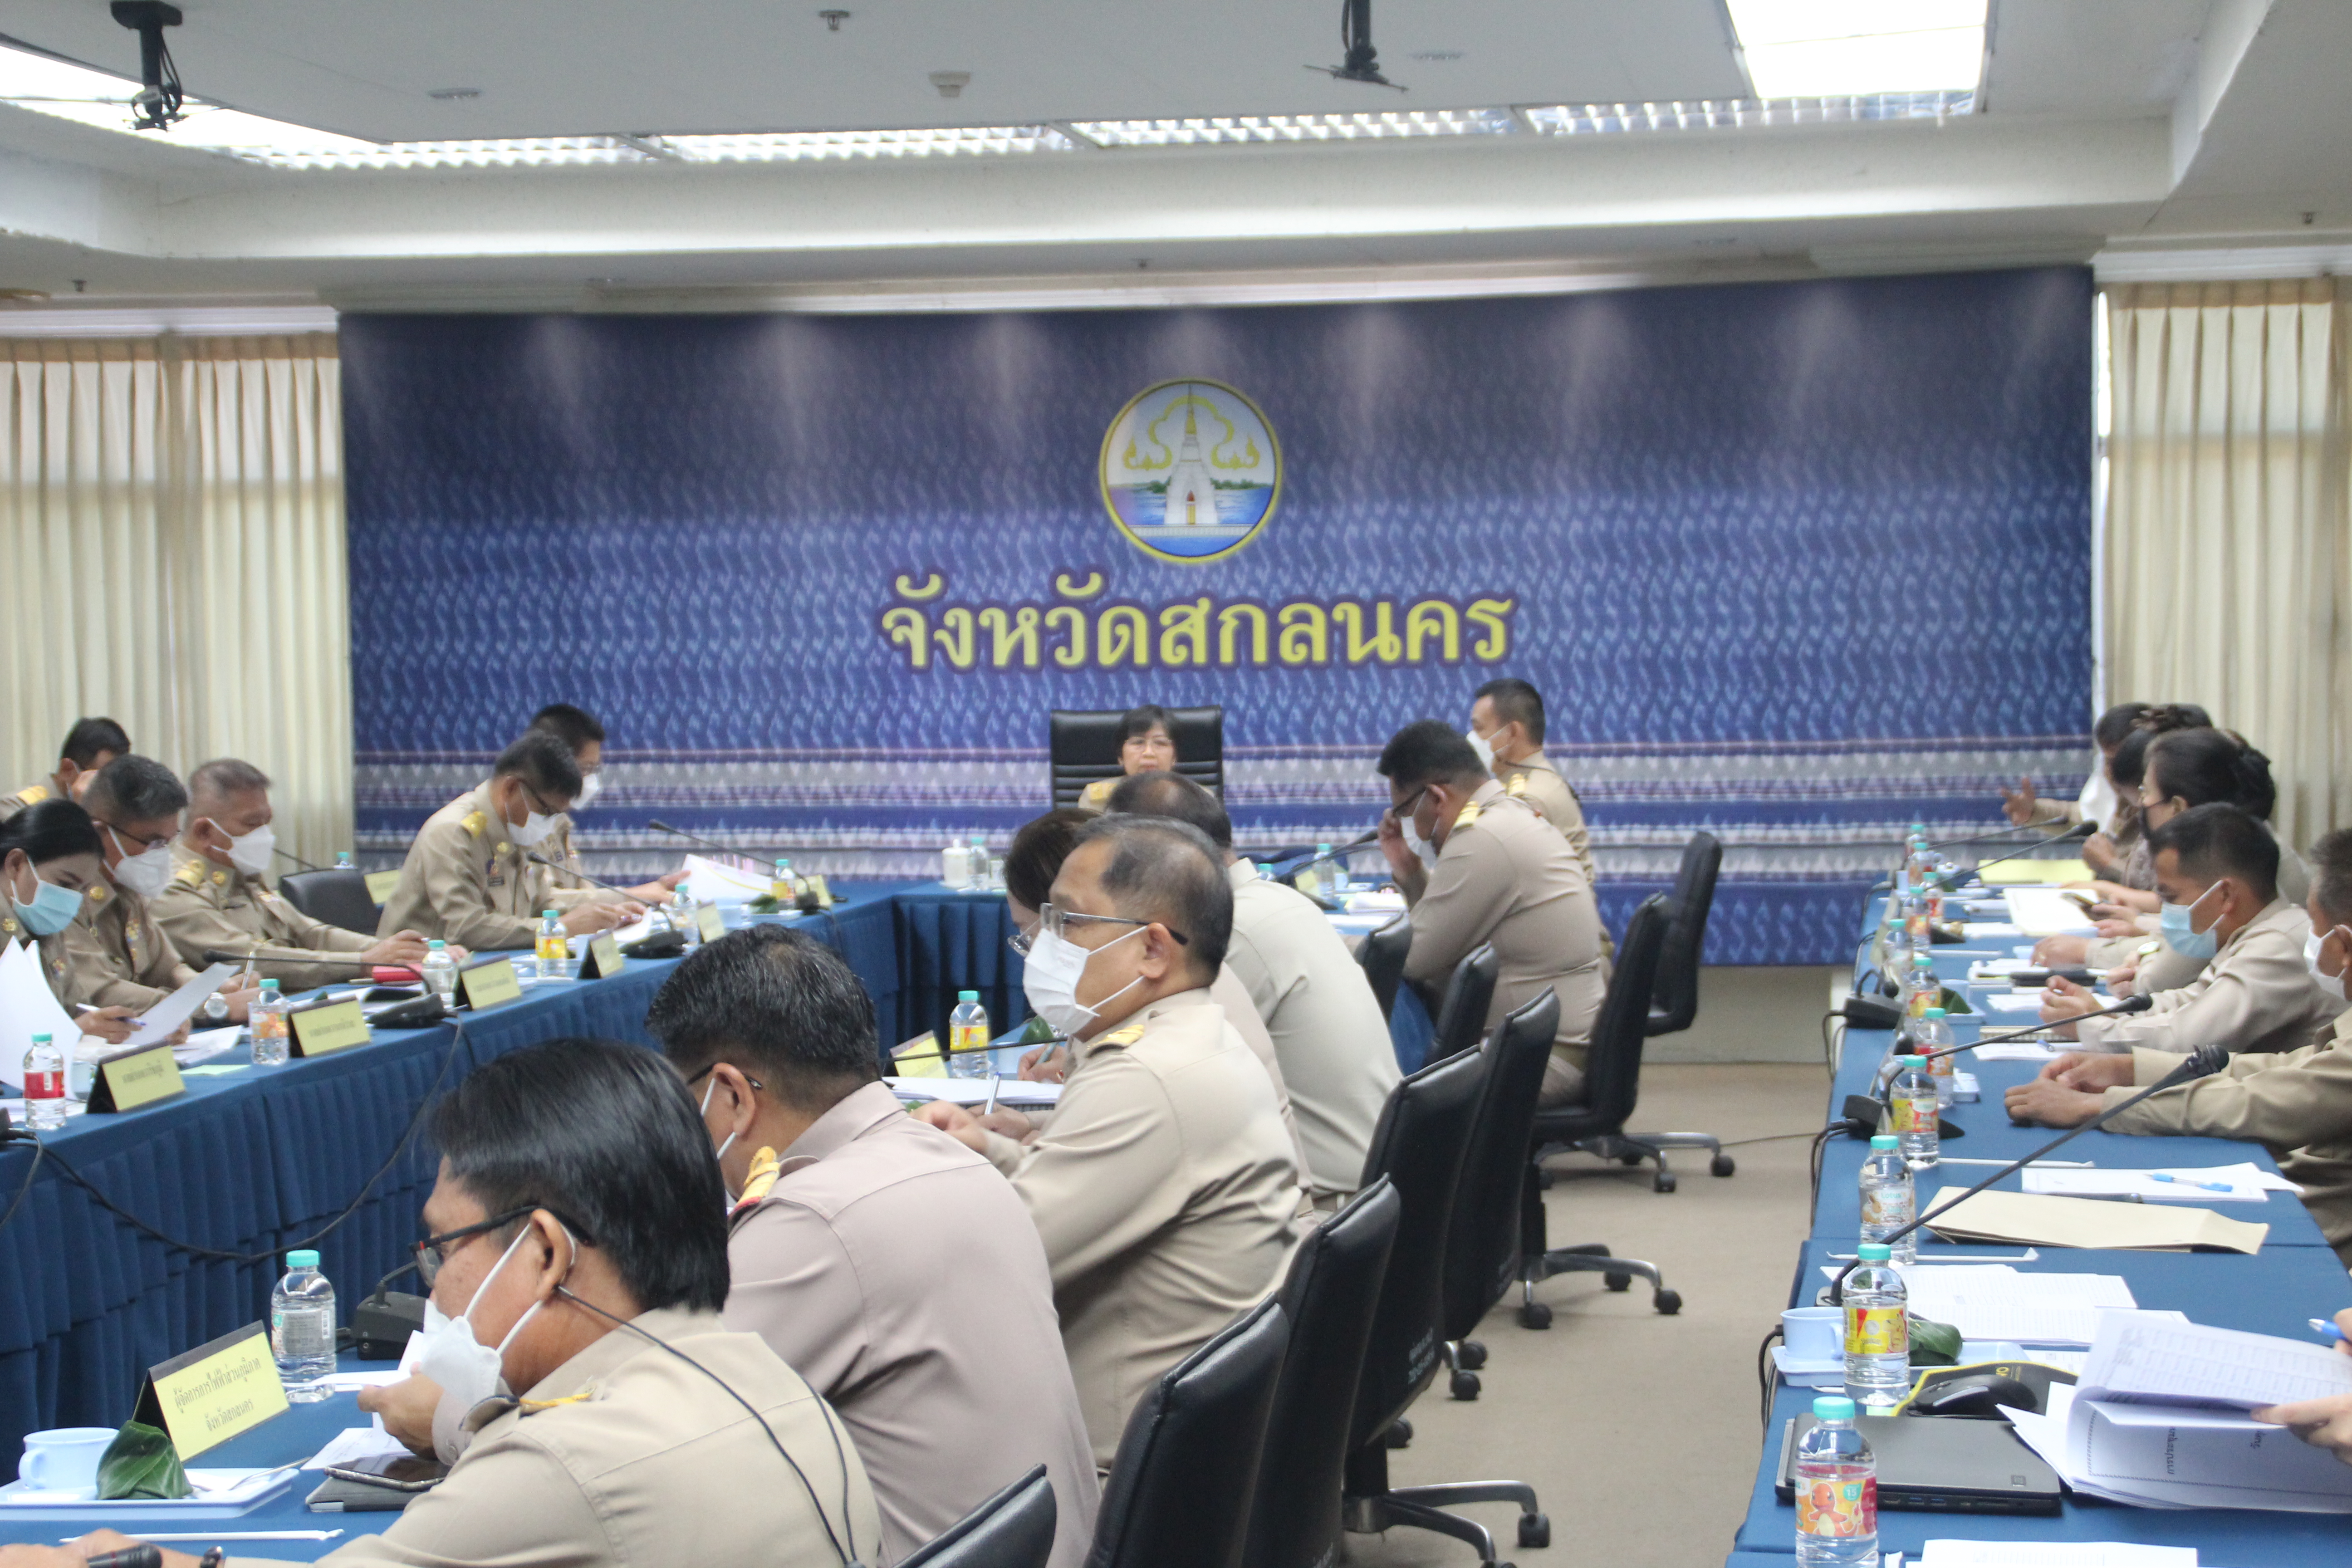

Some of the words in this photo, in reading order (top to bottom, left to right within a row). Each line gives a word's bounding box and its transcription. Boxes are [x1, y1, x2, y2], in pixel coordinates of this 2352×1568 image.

[882, 572, 1512, 667] จังหวัดสกลนคร
[174, 1357, 261, 1413] ผู้จัดการการไฟฟ้าส่วนภูมิภาค
[204, 1399, 254, 1431] จังหวัดสกลนคร
